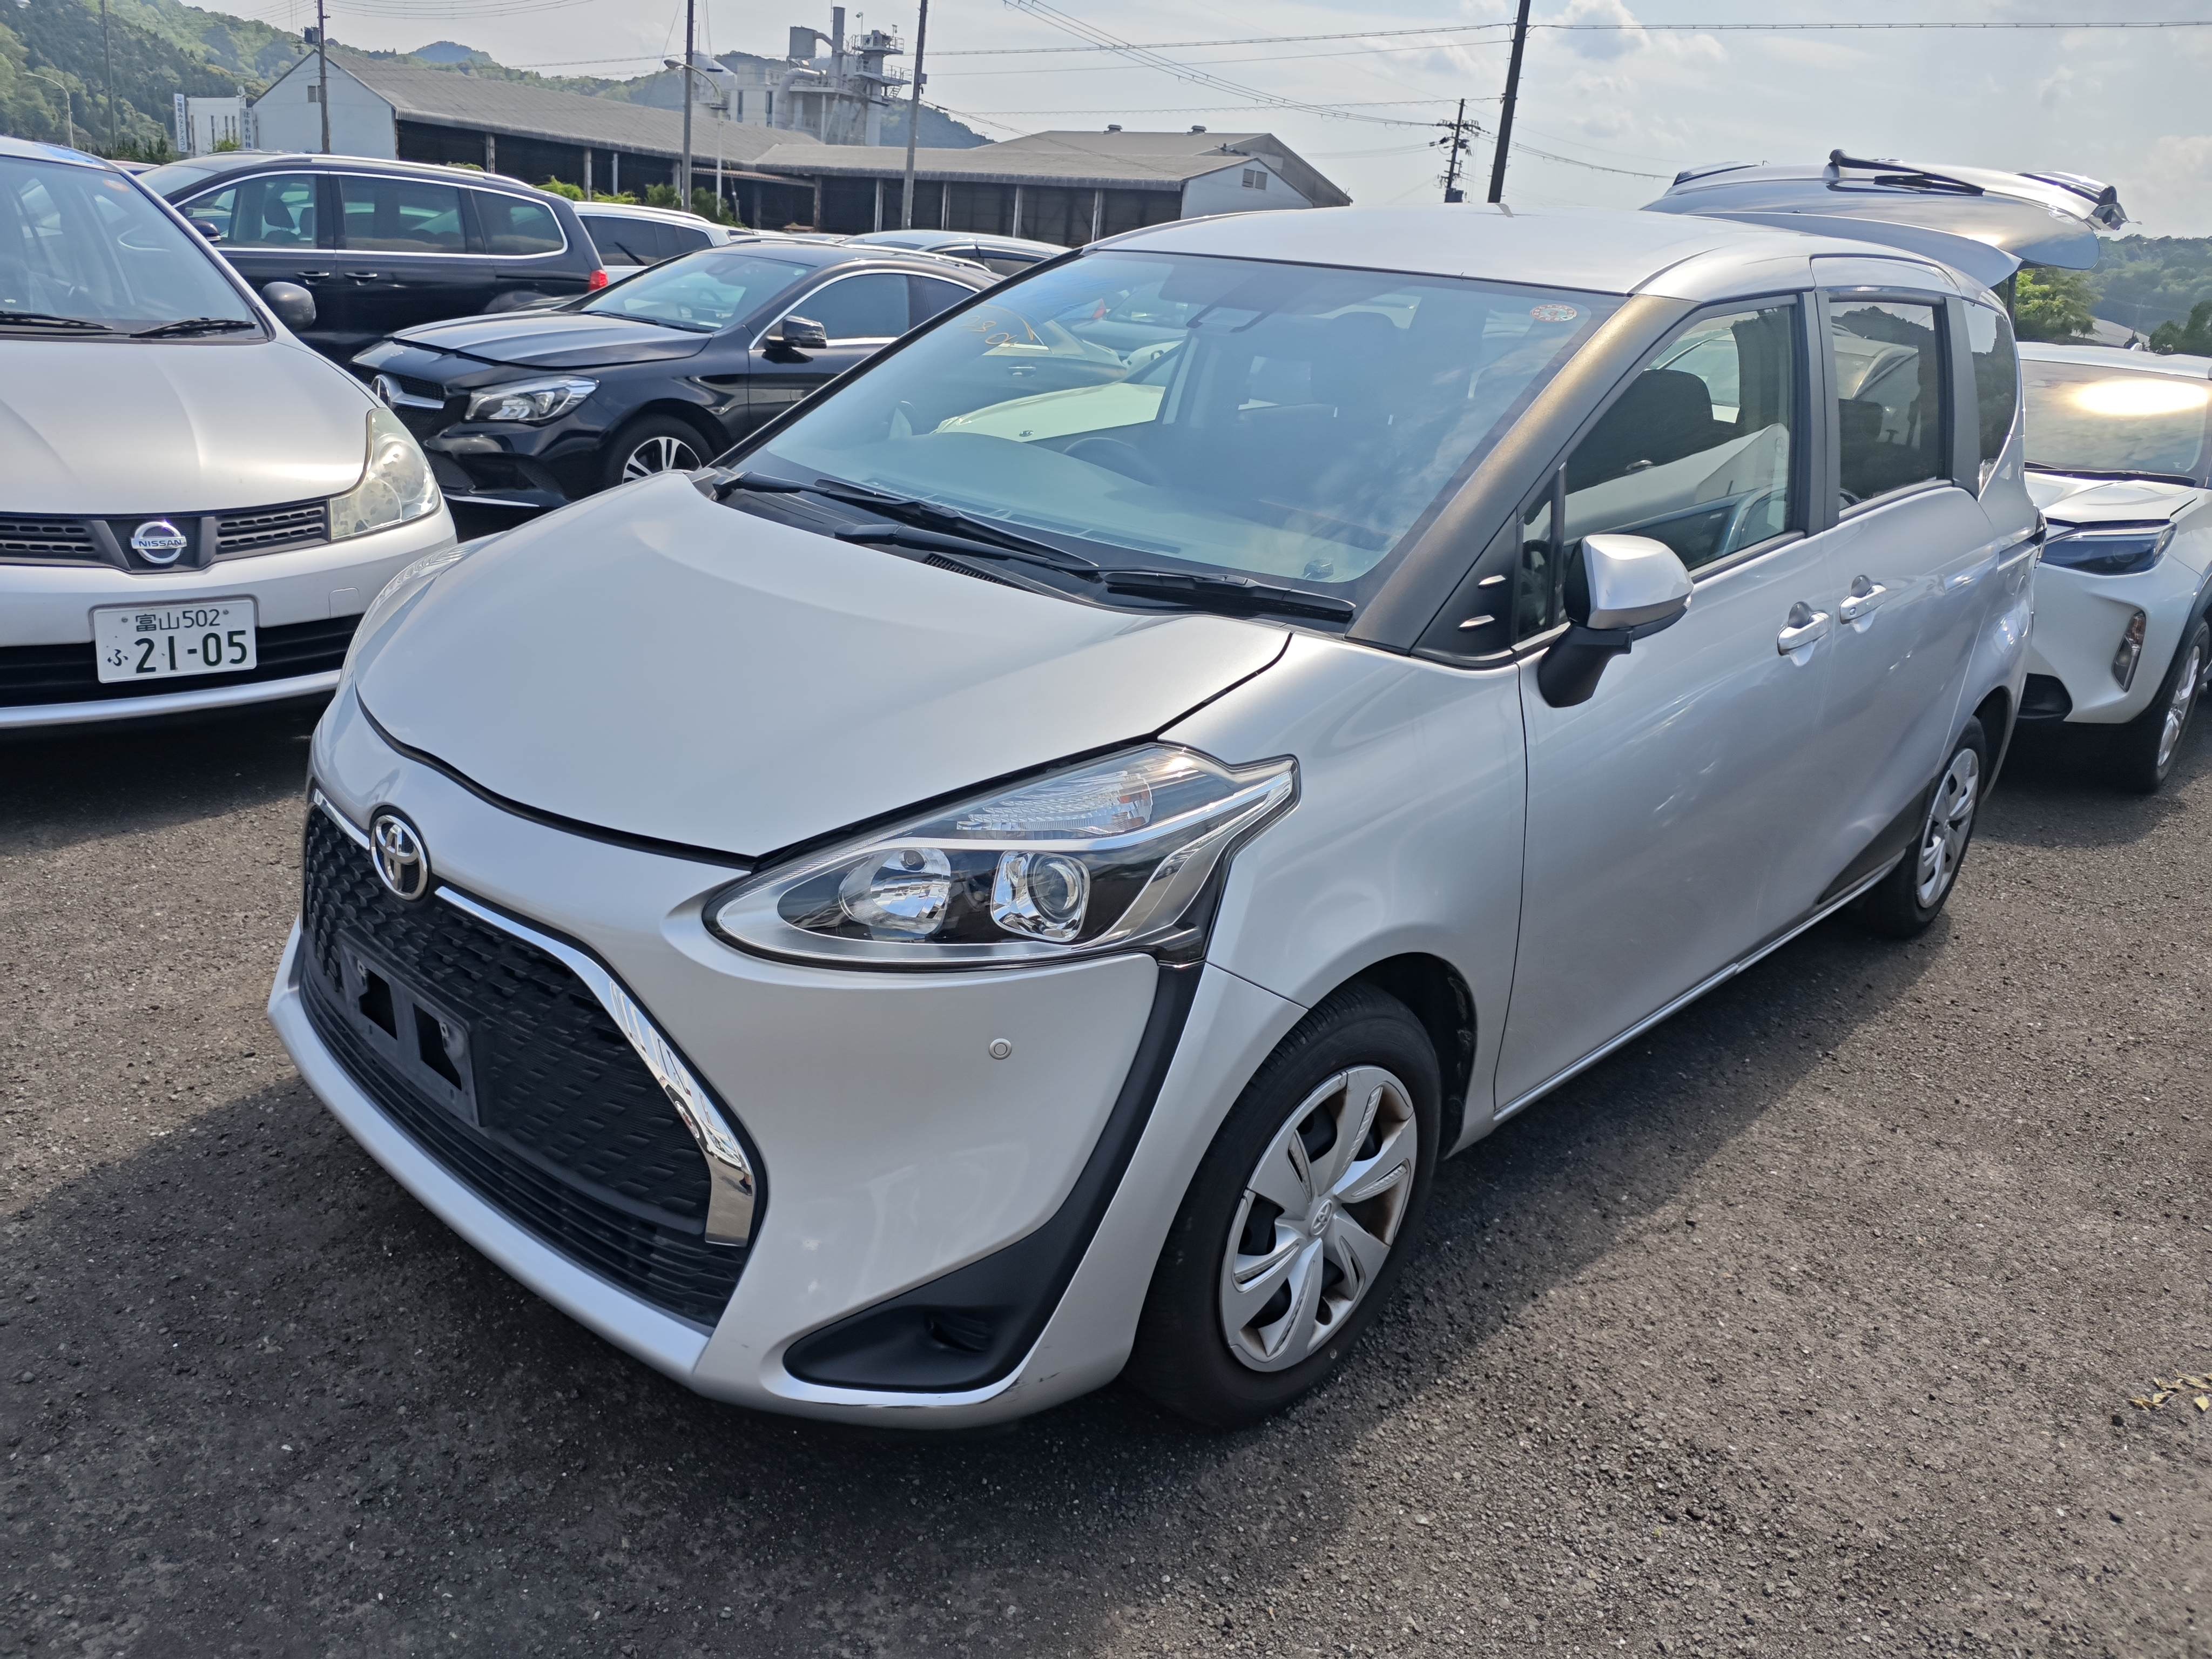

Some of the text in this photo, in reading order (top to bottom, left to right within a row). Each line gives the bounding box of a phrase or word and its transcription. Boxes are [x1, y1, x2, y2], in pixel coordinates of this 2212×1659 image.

[138, 539, 182, 547] NISSAN
[135, 609, 220, 632] 富山502
[107, 630, 247, 674] ふ 21-05
